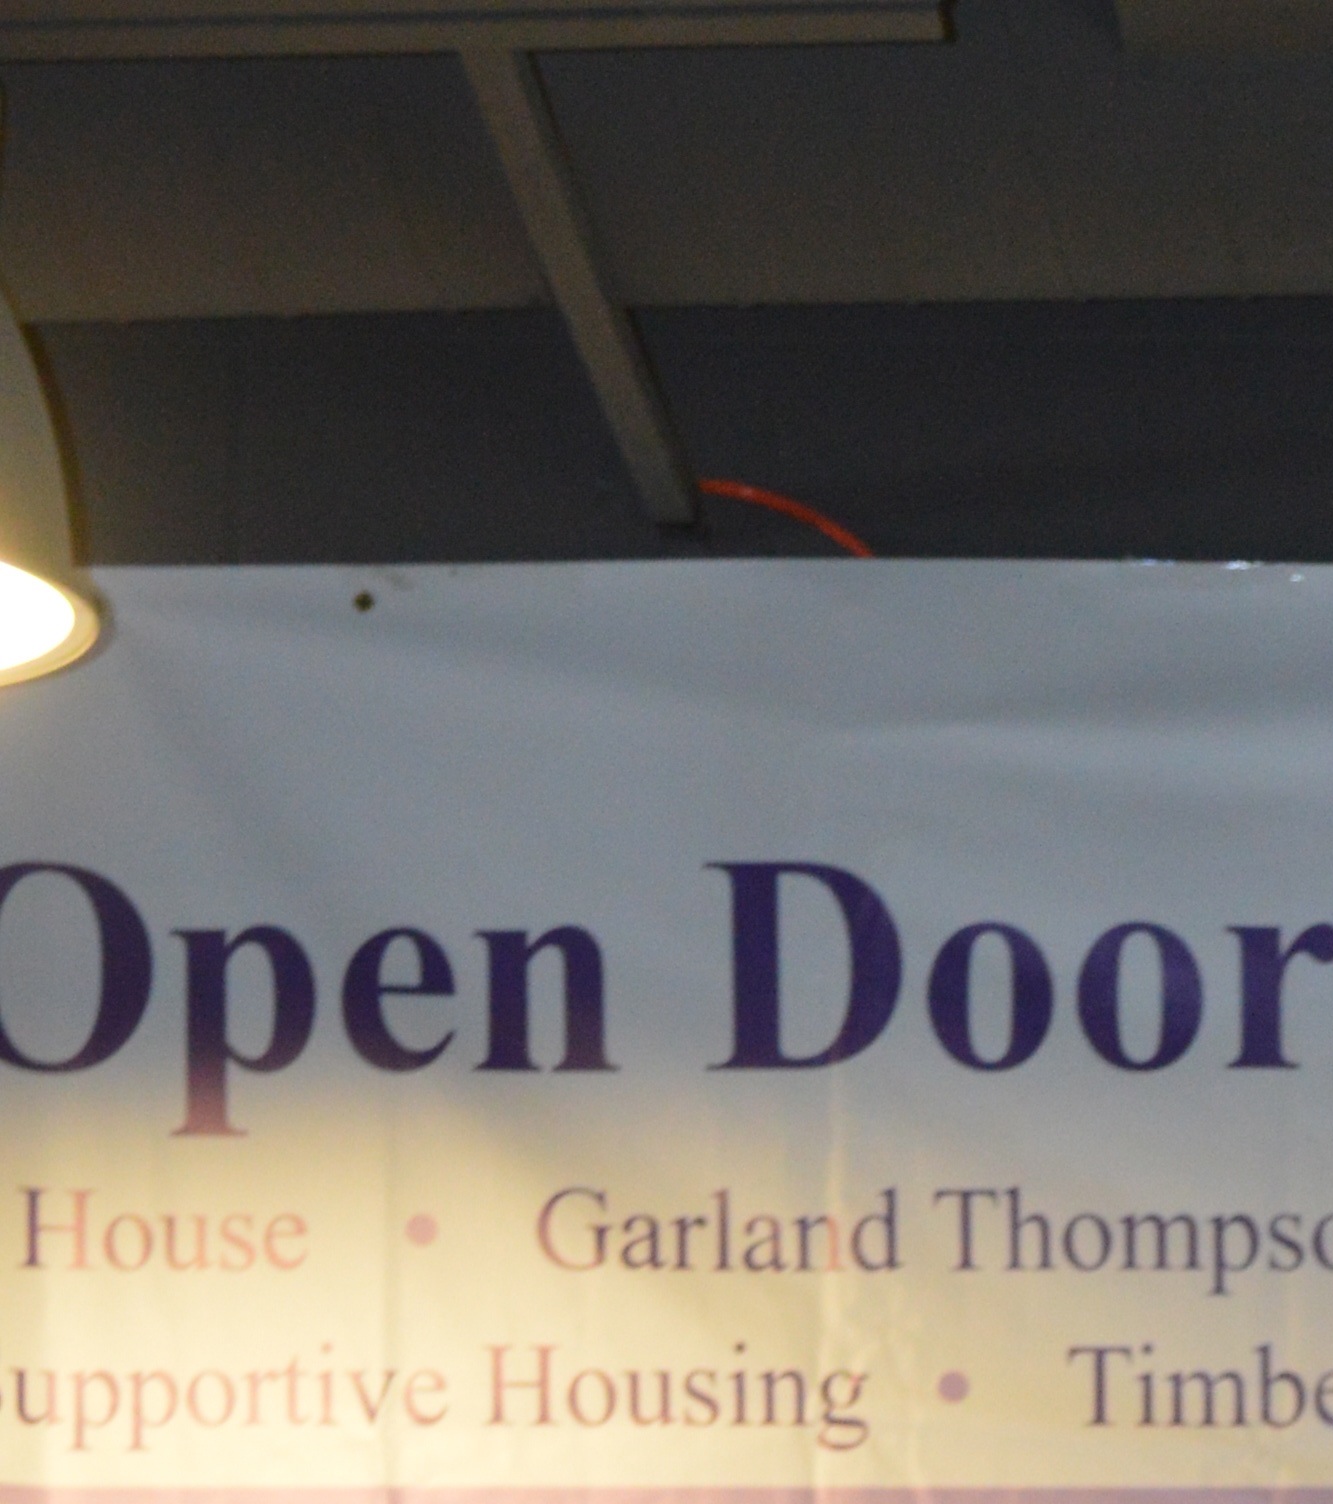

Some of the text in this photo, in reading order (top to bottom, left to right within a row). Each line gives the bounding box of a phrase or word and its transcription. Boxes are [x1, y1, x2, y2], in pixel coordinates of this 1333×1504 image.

[0, 859, 622, 1137] Open
[17, 1185, 311, 1273] House
[535, 1185, 904, 1275] Garland
[0, 1343, 451, 1451] upportive
[485, 1342, 870, 1452] Housing
